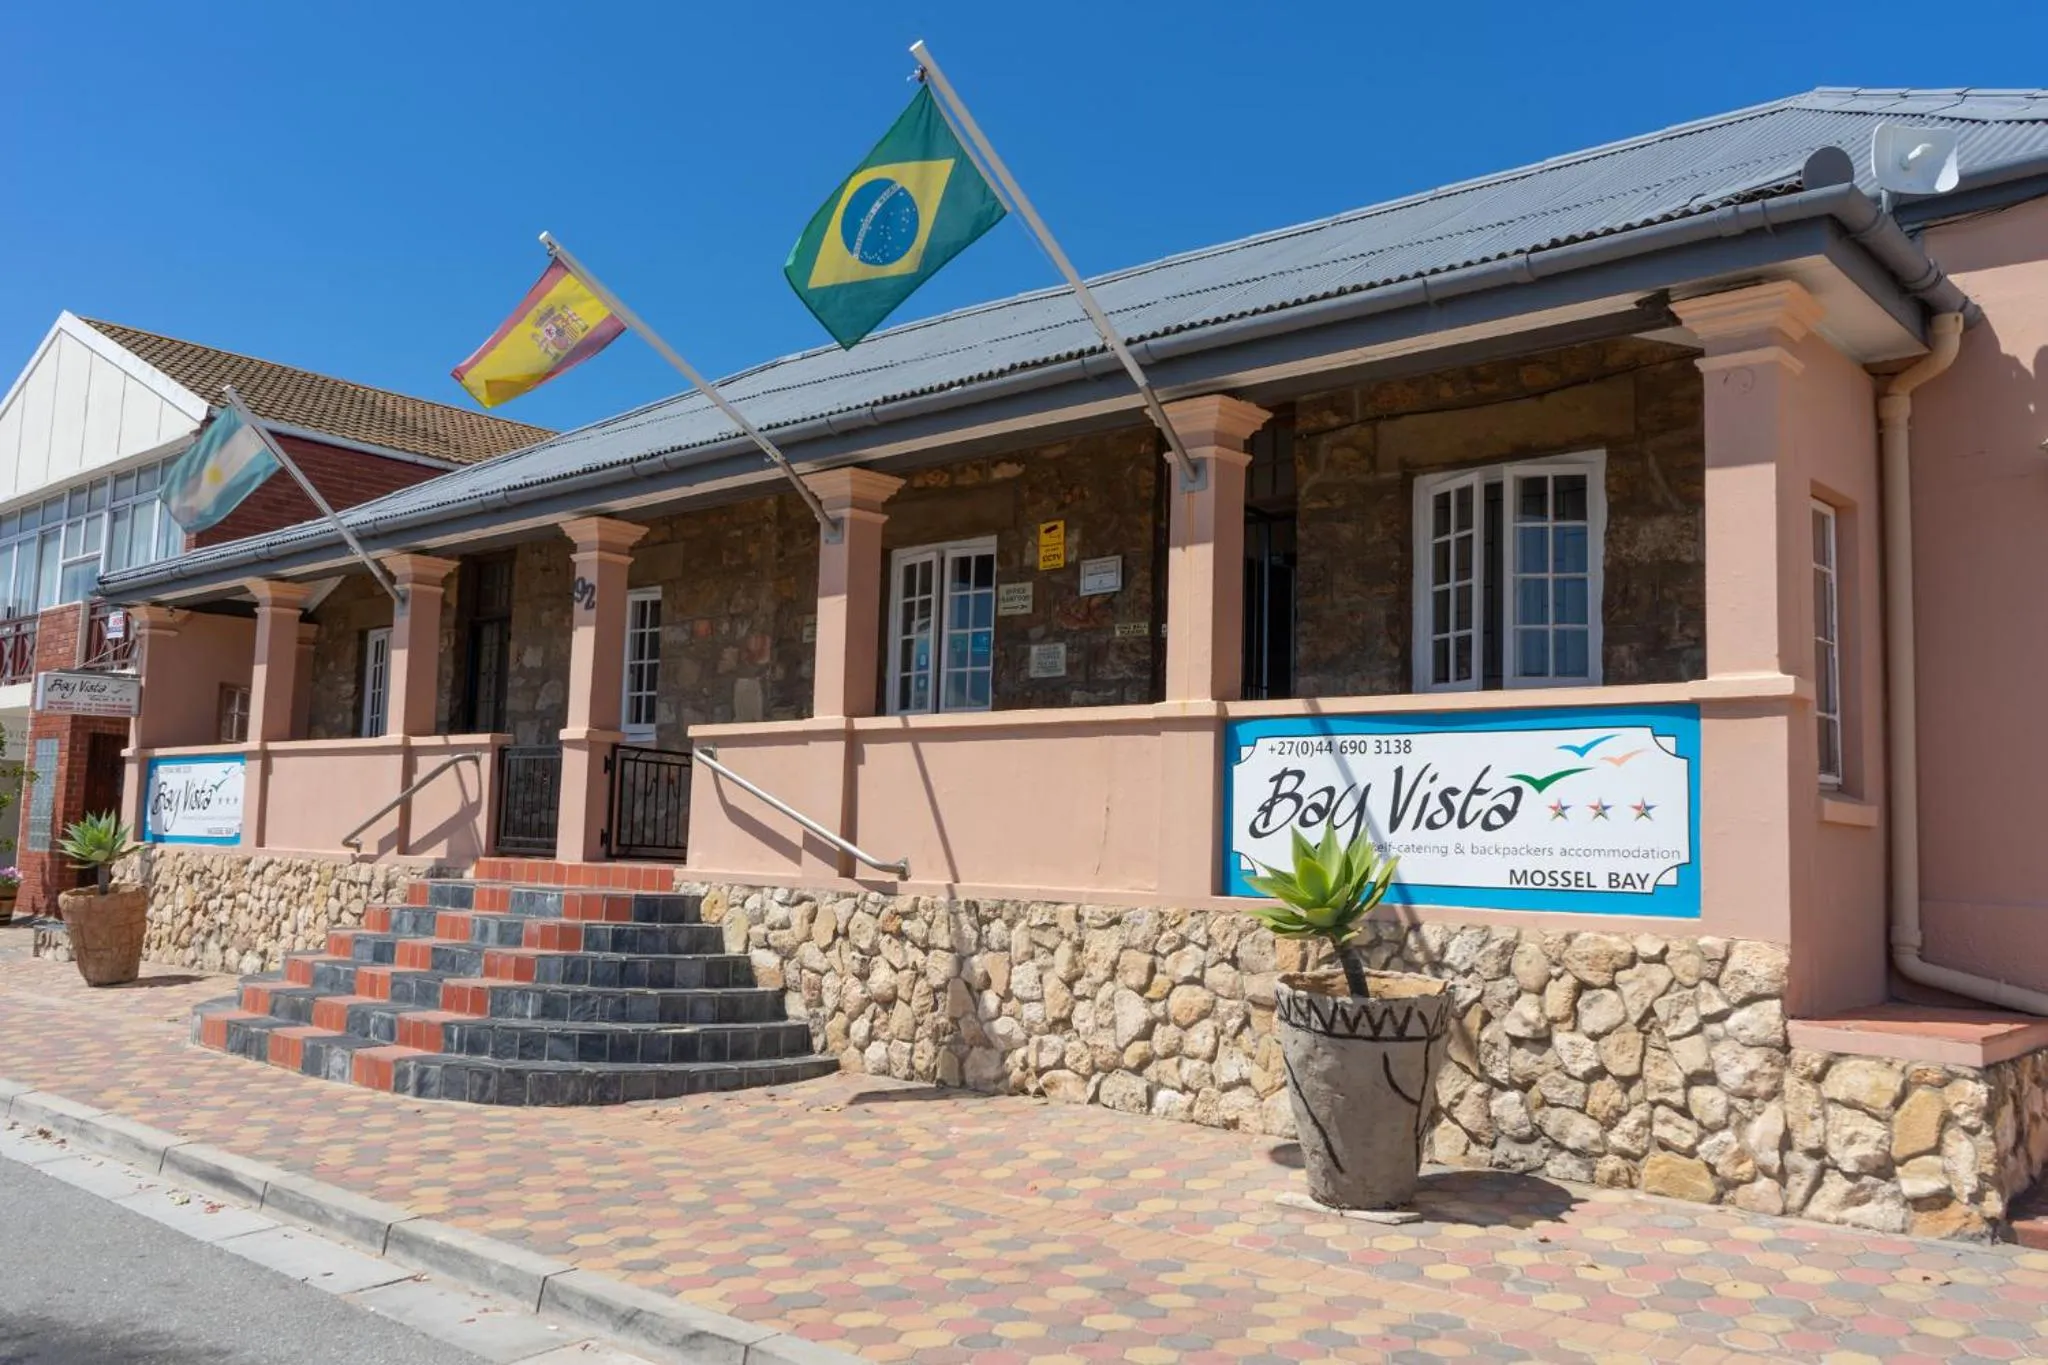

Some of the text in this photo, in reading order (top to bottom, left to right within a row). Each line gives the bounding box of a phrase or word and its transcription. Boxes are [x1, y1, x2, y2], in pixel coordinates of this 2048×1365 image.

[572, 576, 596, 611] 92
[47, 678, 77, 699] Bay
[79, 680, 108, 693] Vista
[1267, 739, 1413, 758] +27(0)44 690 3138
[151, 778, 214, 832] Bay Vista
[1248, 762, 1523, 851] Bay Vista
[1454, 842, 1465, 854] &
[1471, 843, 1554, 857] backpackers
[1559, 845, 1681, 860] accommodation
[1509, 869, 1650, 890] MOSSEL BAY
